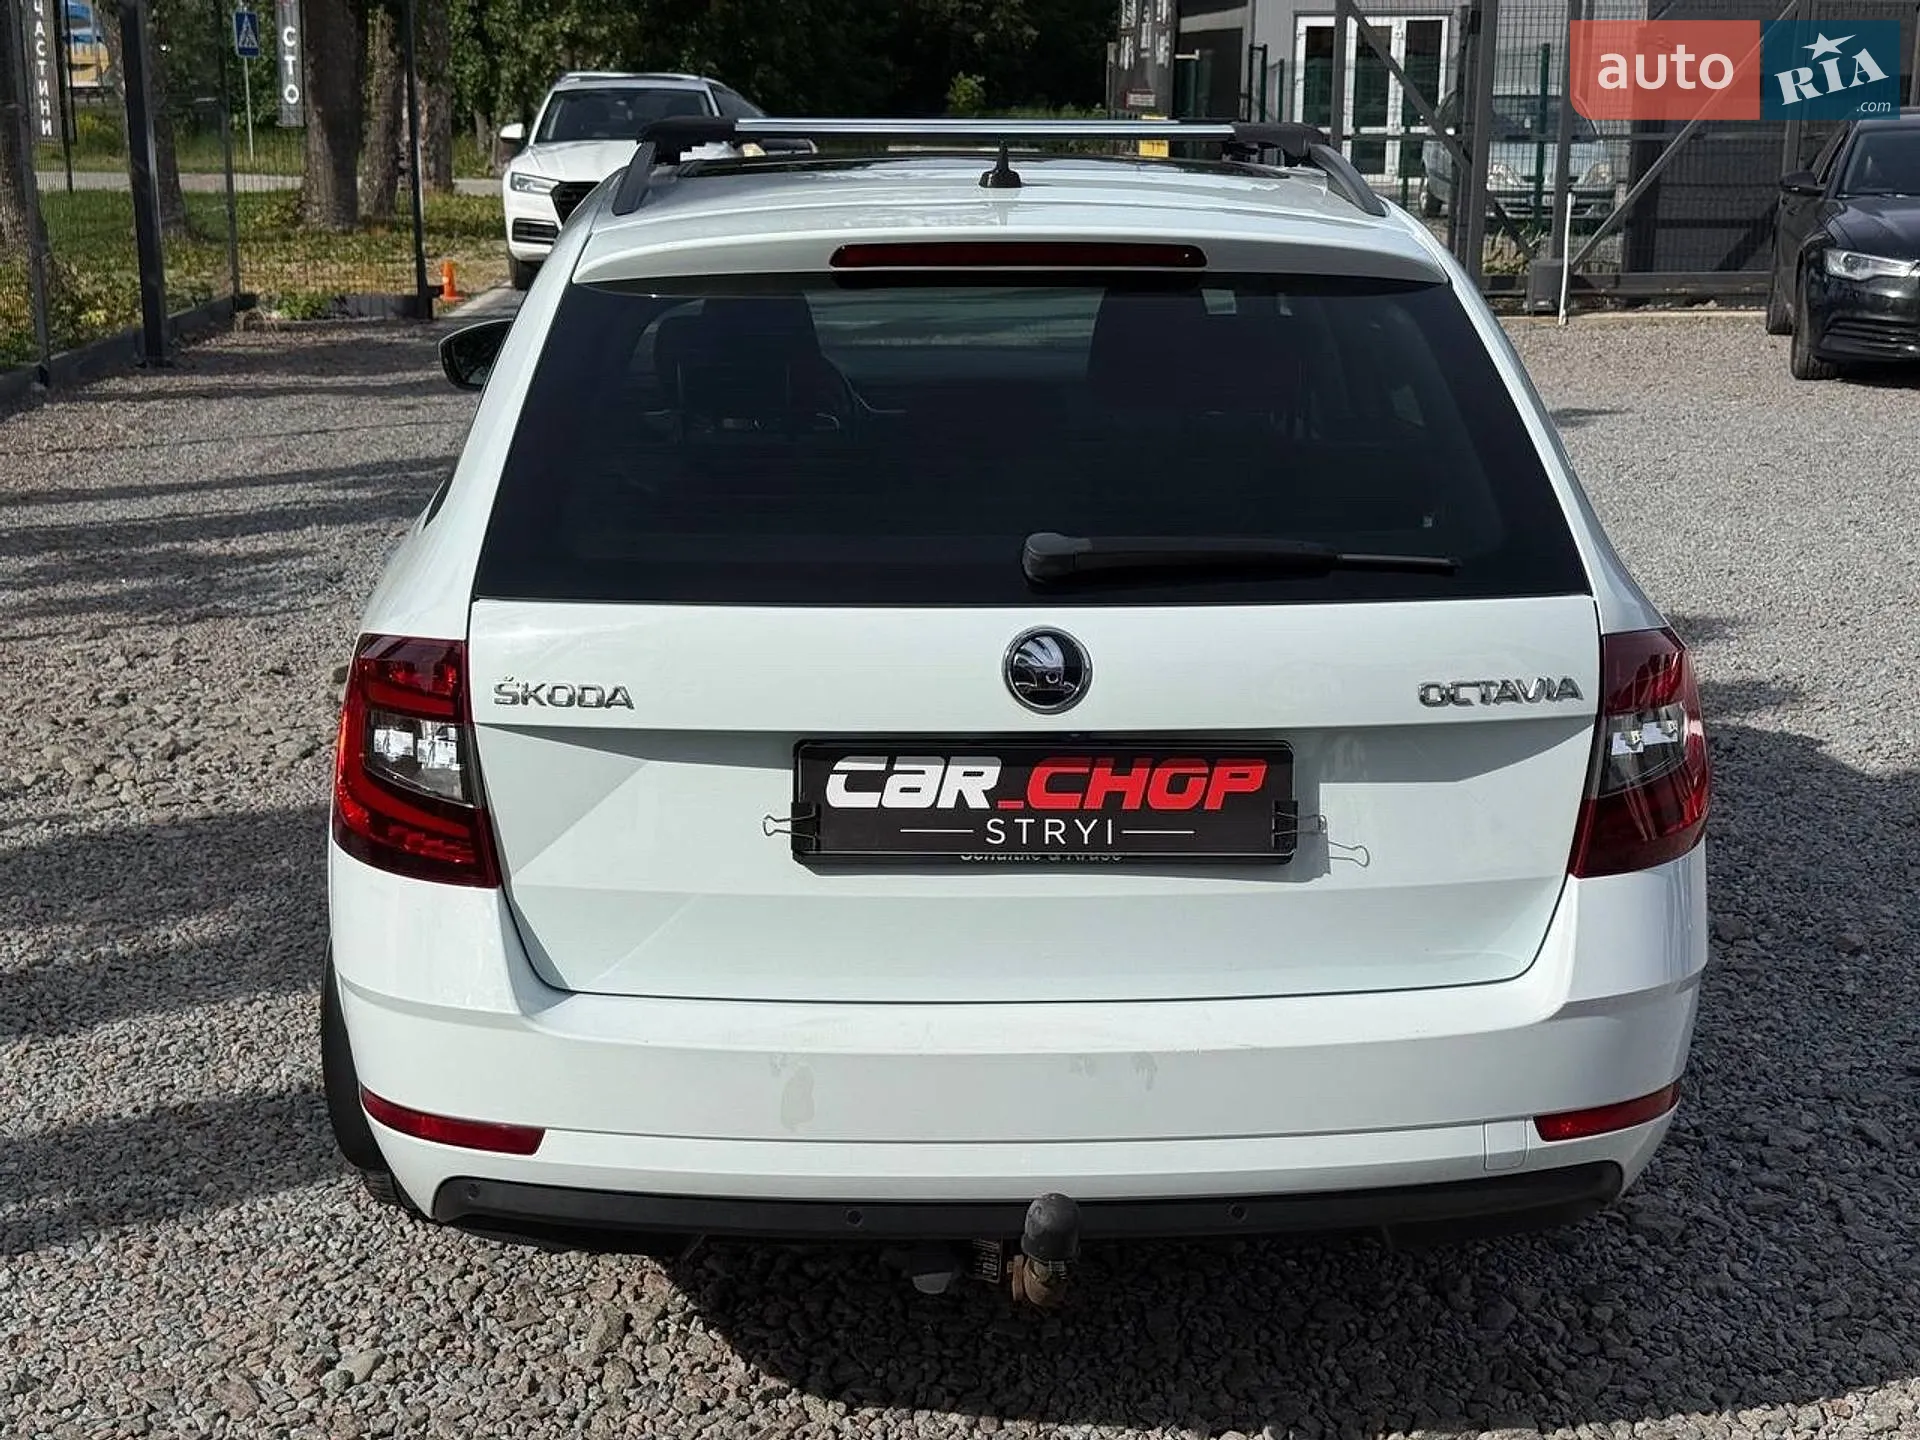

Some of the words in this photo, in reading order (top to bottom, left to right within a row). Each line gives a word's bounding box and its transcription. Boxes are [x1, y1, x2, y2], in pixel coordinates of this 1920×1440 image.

[283, 26, 299, 104] СТО
[493, 675, 635, 710] ŠKODA
[1418, 676, 1585, 707] OCTAVIA
[985, 818, 1113, 845] STRYI
